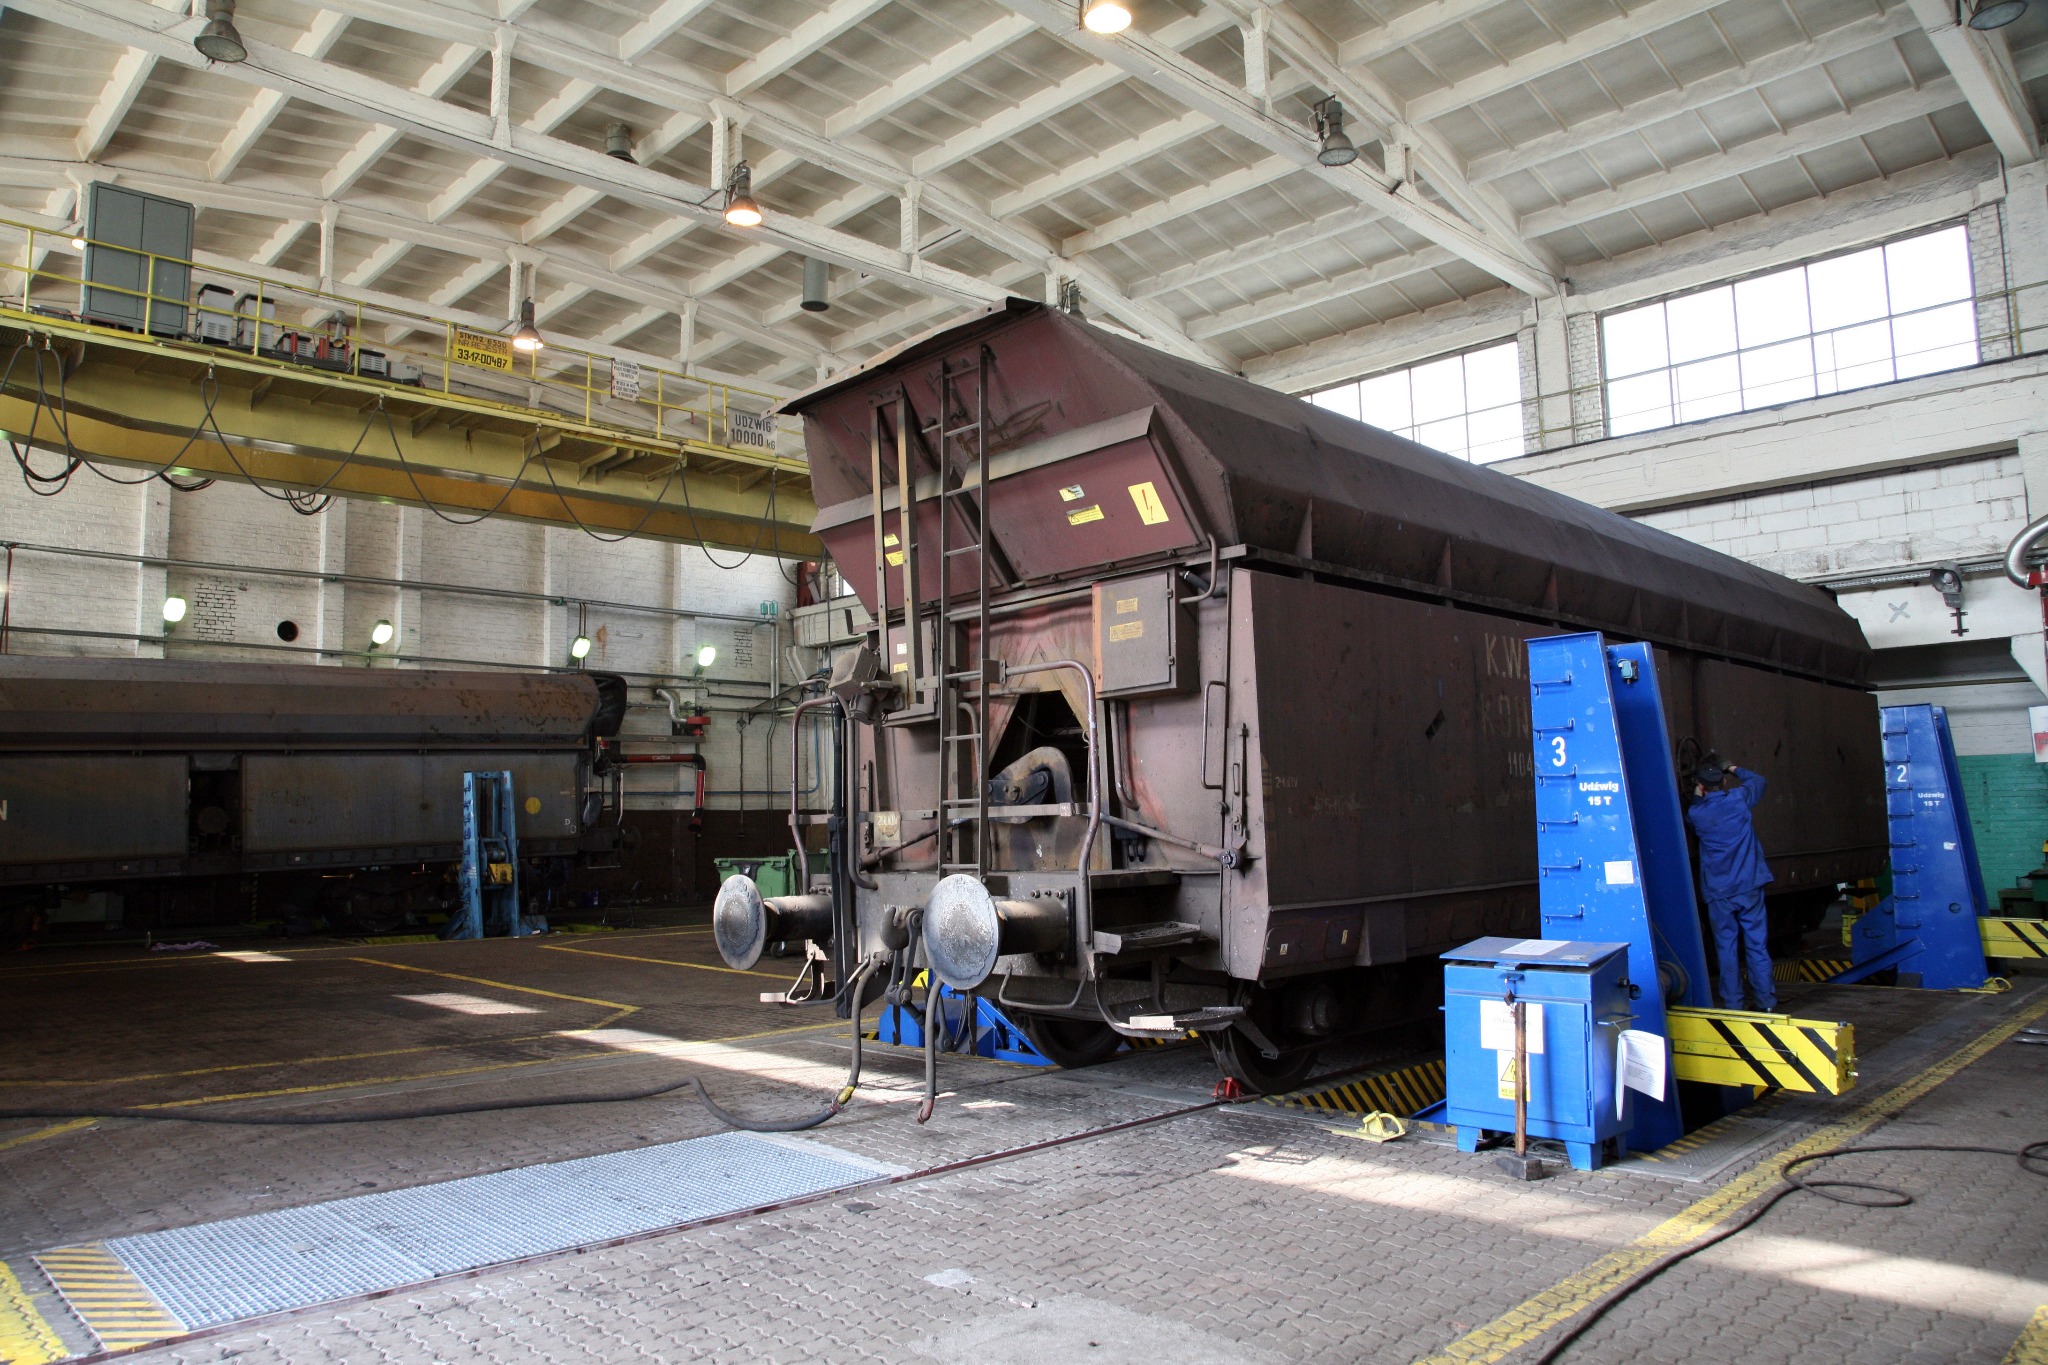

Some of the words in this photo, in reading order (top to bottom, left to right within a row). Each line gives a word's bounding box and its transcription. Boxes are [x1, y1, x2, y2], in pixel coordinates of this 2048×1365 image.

[457, 349, 508, 369] 33-17-00487
[731, 428, 764, 447] 10000
[1551, 736, 1566, 767] 3
[1897, 764, 1907, 782] 2
[1587, 796, 1602, 806] 15
[1603, 796, 1612, 806] T
